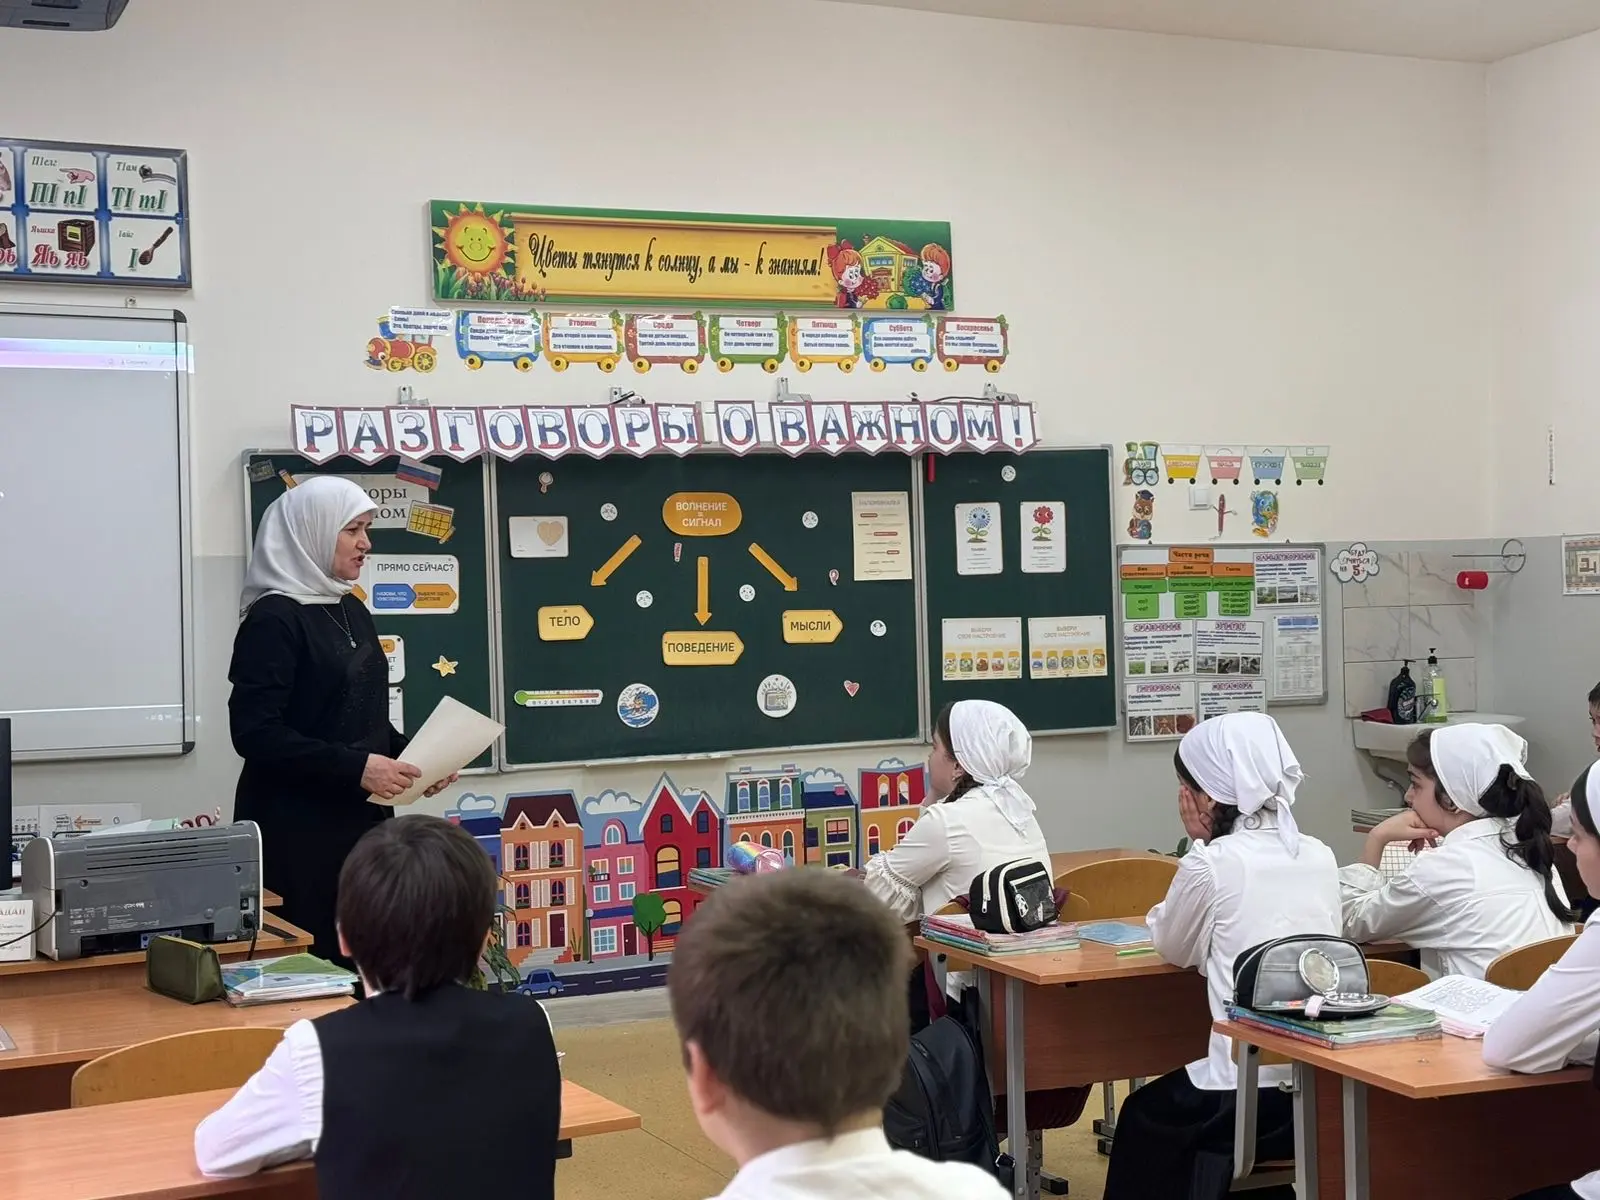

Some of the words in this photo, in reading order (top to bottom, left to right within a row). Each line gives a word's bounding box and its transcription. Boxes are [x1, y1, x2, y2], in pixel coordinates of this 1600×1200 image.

[529, 233, 578, 278] Цветы
[582, 250, 640, 281] тянутся
[644, 237, 656, 272] к
[658, 251, 702, 284] солнцу,
[708, 255, 716, 273] а
[720, 255, 739, 274] мы
[756, 241, 767, 275] к
[768, 247, 824, 277] знаниям!
[736, 319, 762, 328] Четверг
[812, 321, 838, 330] Пятница
[889, 324, 913, 333] Суббота
[956, 324, 994, 333] Воскресенье
[301, 409, 702, 453] РАЗГОВОРЫ
[721, 405, 754, 447] О
[775, 404, 1023, 447] ВАЖНОМ!
[676, 501, 727, 511] ВОЛНЕНИЕ
[682, 518, 722, 528] СИГНАЛ
[377, 563, 410, 572] ПРЯМО
[412, 561, 455, 572] СЕЙЧАС?
[549, 616, 580, 627] ТЕЛО
[790, 621, 831, 631] МЫСЛИ
[667, 642, 735, 654] ПОВЕДЕНИЕ
